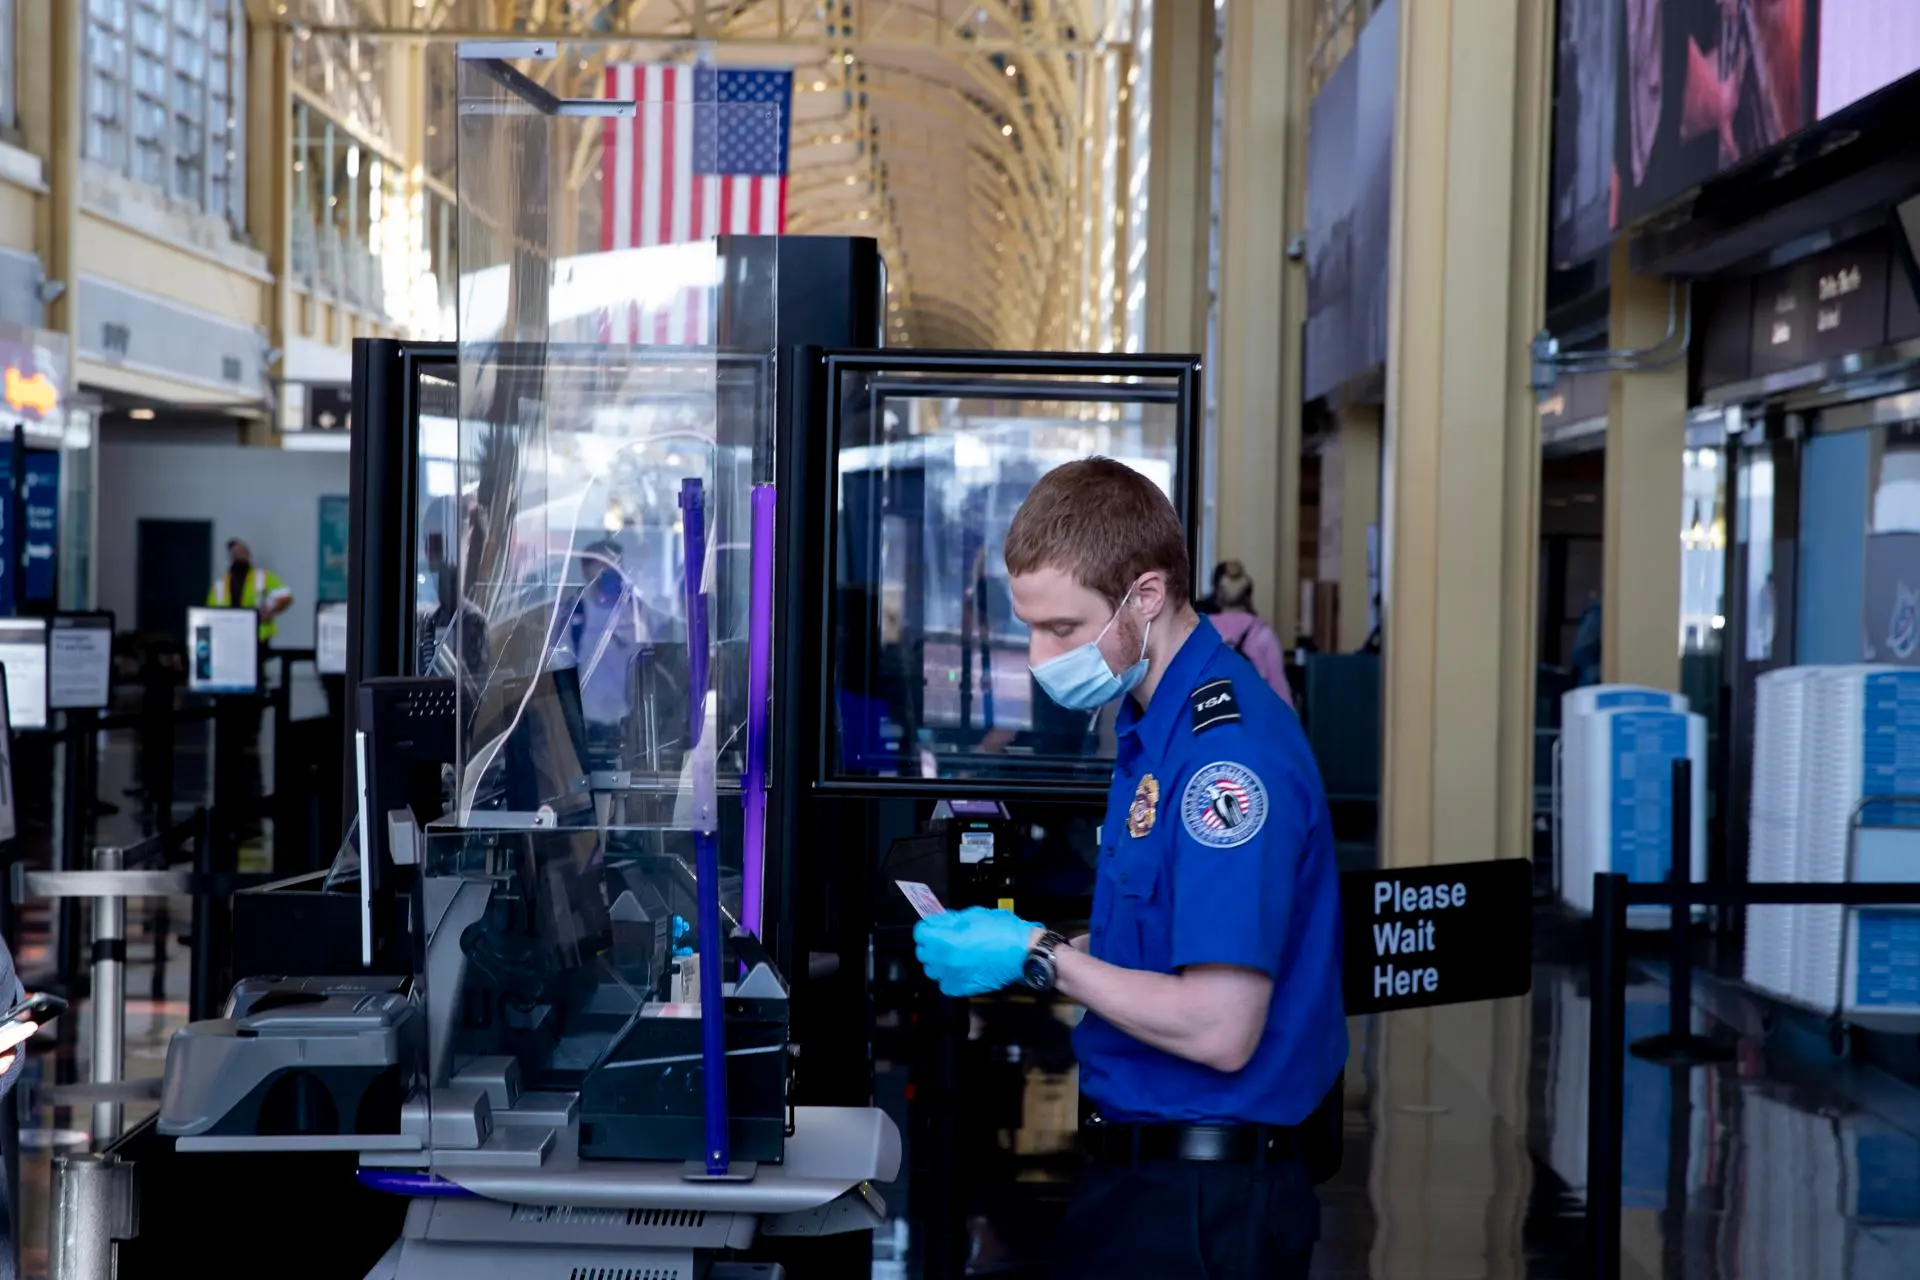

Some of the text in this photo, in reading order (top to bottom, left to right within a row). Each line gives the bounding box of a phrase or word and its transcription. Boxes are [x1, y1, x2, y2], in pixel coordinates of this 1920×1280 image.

[1194, 693, 1231, 711] TSA
[1374, 880, 1466, 915] Please
[1373, 919, 1435, 956] Wait
[1374, 964, 1439, 998] Here
